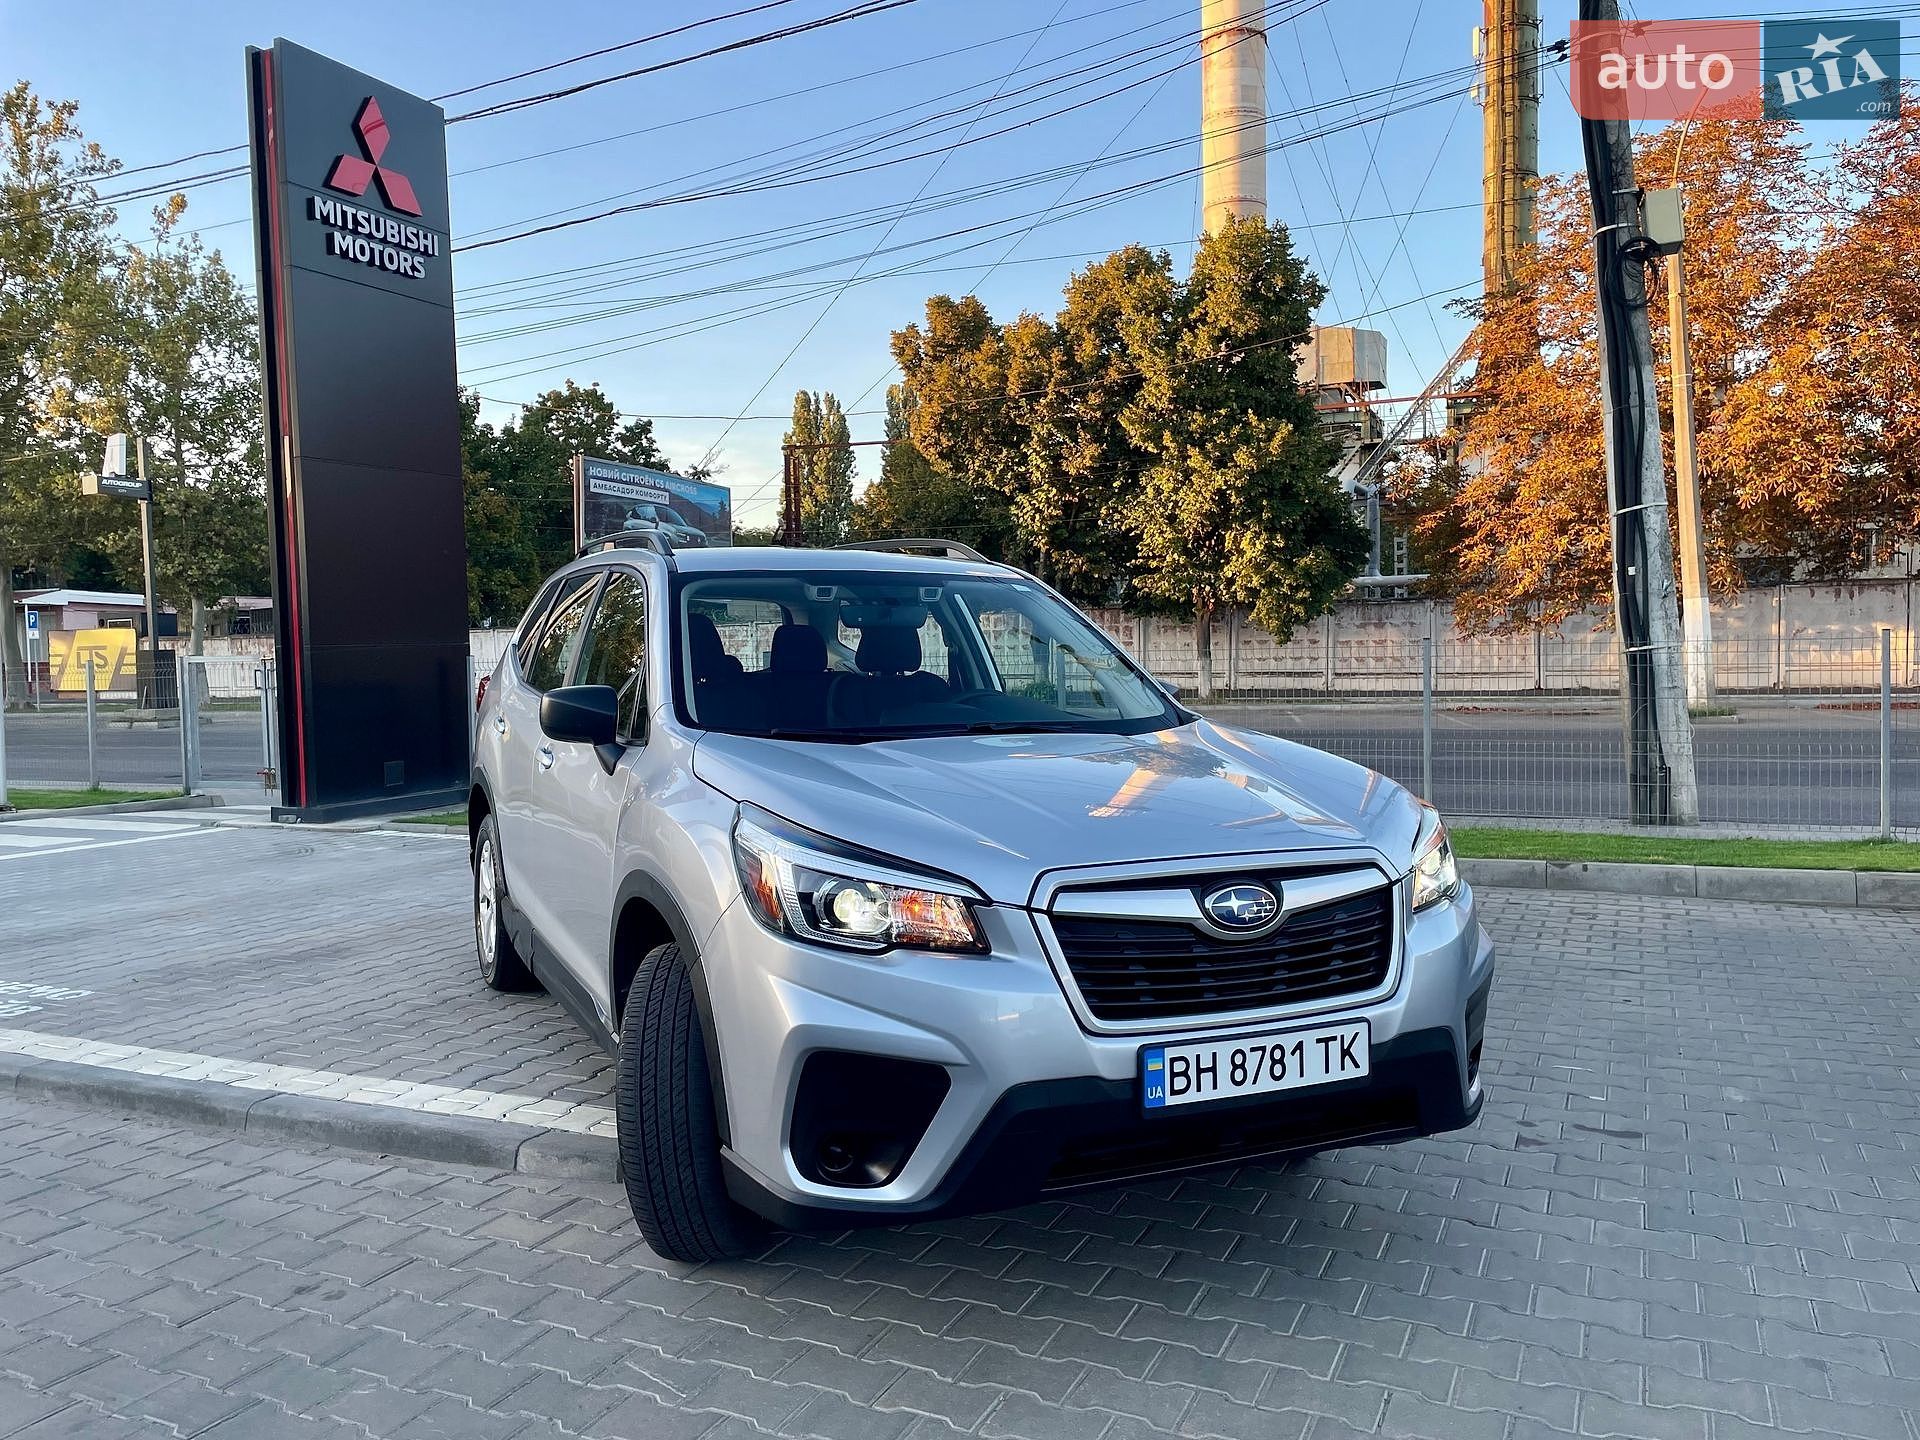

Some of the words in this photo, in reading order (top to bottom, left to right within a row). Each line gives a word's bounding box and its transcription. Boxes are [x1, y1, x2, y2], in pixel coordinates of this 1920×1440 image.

[311, 195, 439, 257] MITSUBISHI
[332, 231, 426, 279] MOTORS
[589, 466, 620, 480] НОВИЙ
[102, 479, 143, 488] AUTOGROUP
[593, 482, 634, 496] АМБАСАДОР
[635, 488, 668, 502] КОМФОРТУ
[1169, 1051, 1218, 1097] BH
[1230, 1040, 1304, 1087] 8781
[1315, 1031, 1361, 1074] TK
[1147, 1088, 1164, 1099] UA
